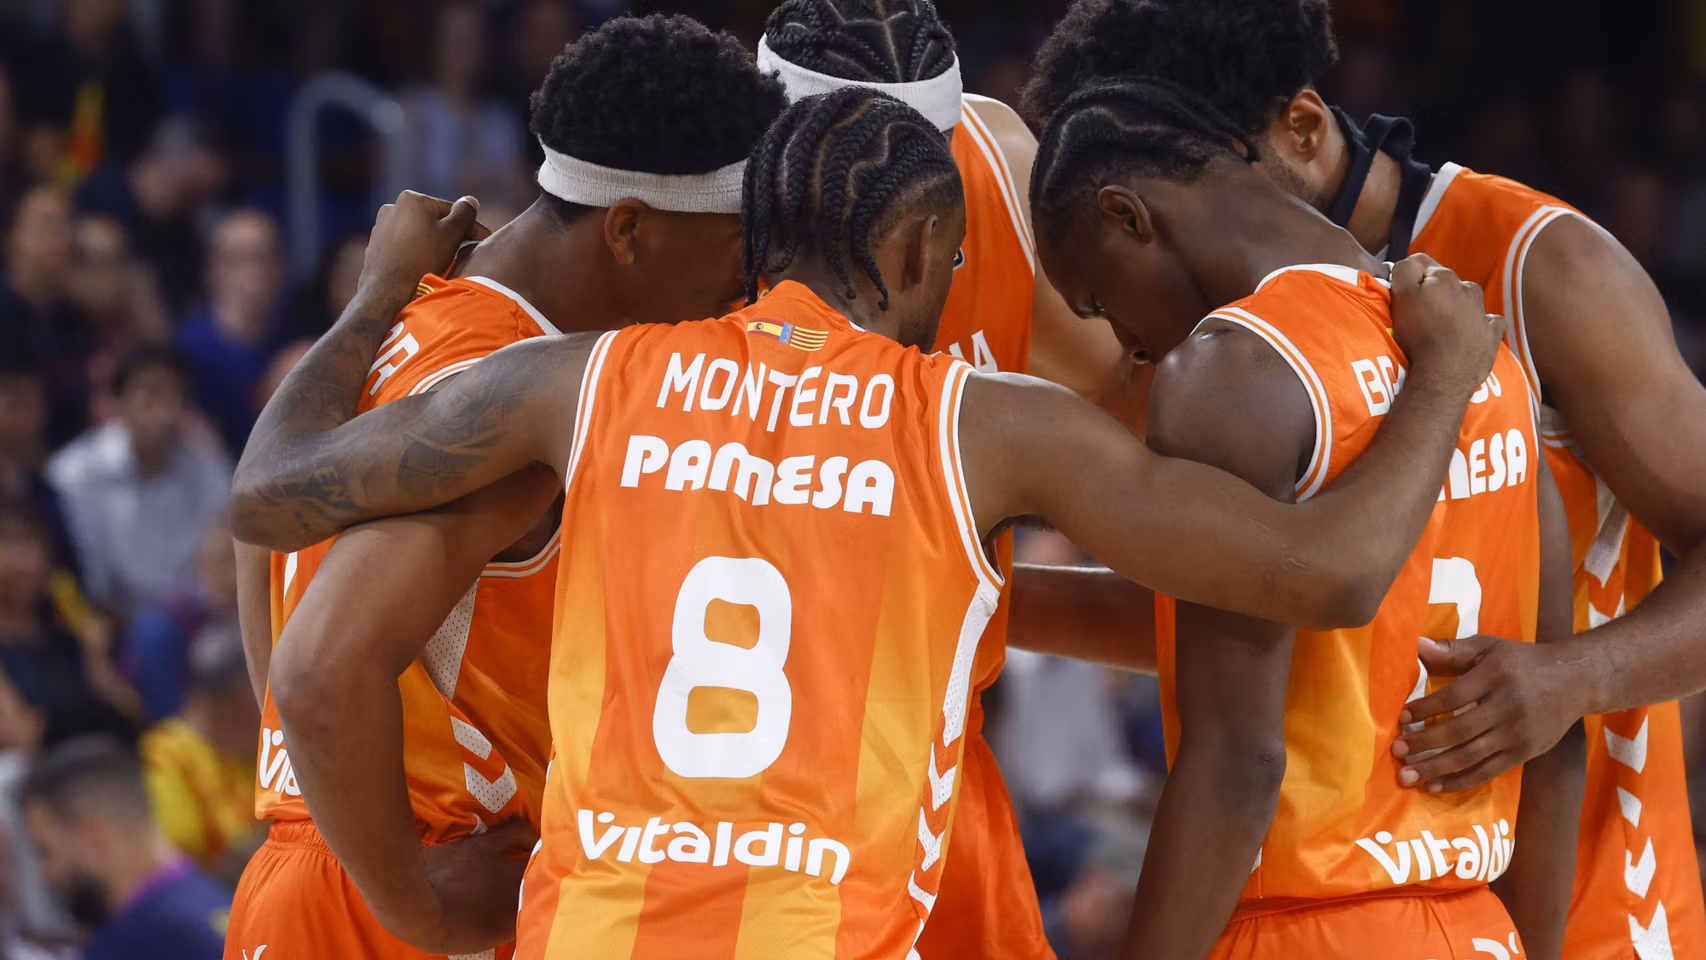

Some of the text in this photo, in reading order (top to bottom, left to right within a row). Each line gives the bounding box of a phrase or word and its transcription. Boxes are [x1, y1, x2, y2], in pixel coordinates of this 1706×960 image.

[656, 352, 895, 432] MONTERO
[620, 435, 895, 517] PAMESA
[652, 555, 792, 778] 8
[1355, 818, 1516, 884] Vitaldi
